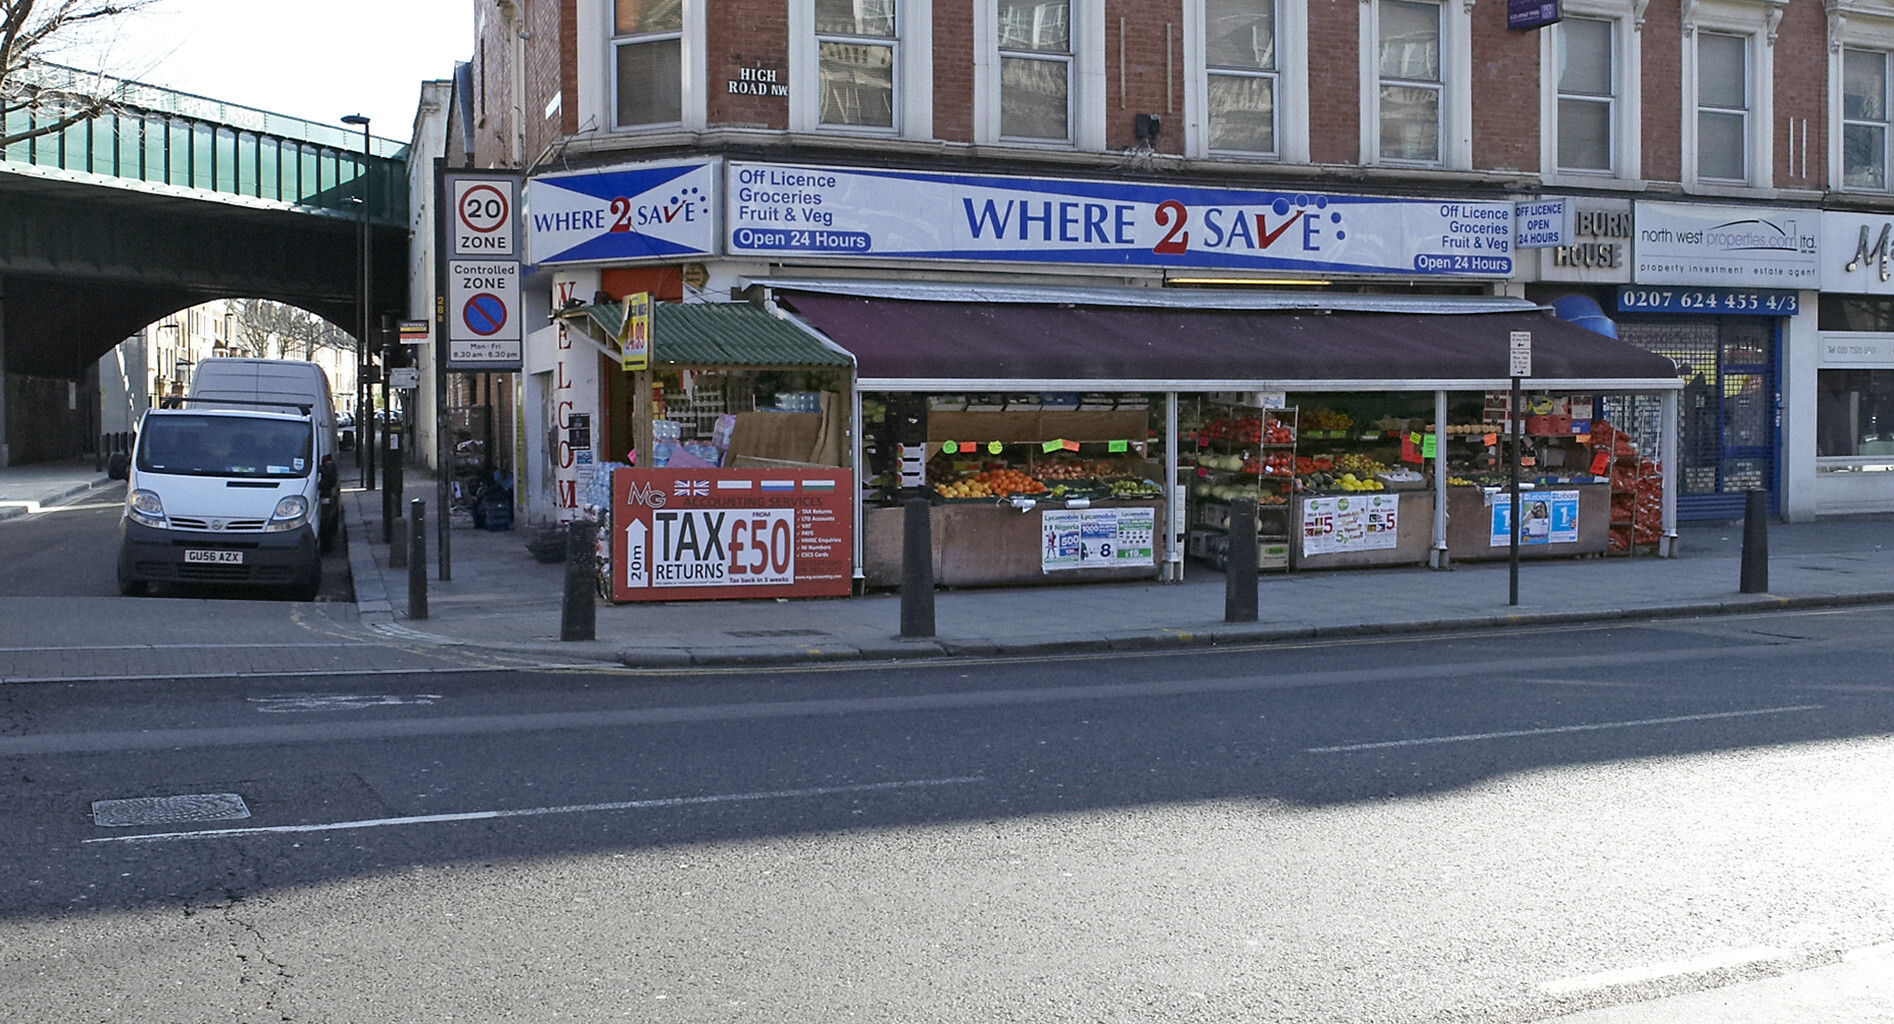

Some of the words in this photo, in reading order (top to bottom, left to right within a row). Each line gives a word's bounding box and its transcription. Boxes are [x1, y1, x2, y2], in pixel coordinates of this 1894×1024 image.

[740, 68, 777, 82] HIGH
[728, 81, 767, 95] ROAD
[771, 84, 789, 96] NW
[739, 169, 766, 184] Off
[770, 171, 836, 187] Licence
[739, 187, 822, 205] Groceries
[467, 199, 501, 219] 20
[534, 209, 605, 232] WHERE
[609, 196, 632, 234] 2
[637, 200, 695, 226] SAVE
[739, 205, 779, 221] Fruit
[784, 207, 796, 222] &
[801, 207, 833, 227] Veg
[1440, 205, 1459, 217] Off
[1462, 206, 1509, 220] Licence
[1515, 206, 1529, 217] OFF
[1531, 204, 1562, 216] LICENCE
[962, 197, 1135, 244] WHERE
[1152, 199, 1189, 255] 2
[1203, 208, 1321, 252] SAVE
[1450, 220, 1508, 235] Groceries
[1527, 219, 1550, 231] OPEN
[461, 236, 506, 249] ZONE
[739, 229, 785, 248] Open
[790, 231, 811, 246] 24
[816, 231, 866, 248] Hours
[1442, 236, 1470, 248] Fruit
[1473, 237, 1482, 249] &
[1486, 237, 1508, 253] Veg
[1519, 234, 1528, 244] 24
[1530, 232, 1559, 243] HOURS
[1641, 228, 1672, 243] north
[1676, 230, 1703, 244] west
[1707, 232, 1797, 248] properties.com
[1418, 256, 1451, 271] Open
[1455, 257, 1469, 269] 24
[1472, 257, 1508, 270] Hours
[1554, 243, 1623, 268] HOUSE
[455, 264, 515, 275] Controlled
[1640, 264, 1684, 274] property
[1689, 265, 1743, 274] investment
[1753, 267, 1783, 276] estate
[1788, 269, 1816, 278] agent
[463, 278, 506, 289] ZONE
[1623, 291, 1673, 307] 0207
[1680, 292, 1717, 308] 624
[1724, 294, 1758, 310] 455
[1766, 295, 1797, 311] 4/3
[627, 481, 667, 508] MG
[683, 497, 767, 508] ACCOUNTING
[769, 497, 823, 508] SERVICES
[656, 512, 726, 561] TAX
[728, 519, 791, 575] £50
[189, 551, 216, 561] GU56
[219, 552, 239, 562] AZX
[631, 545, 642, 581] 20m
[656, 563, 724, 580] RETURNS
